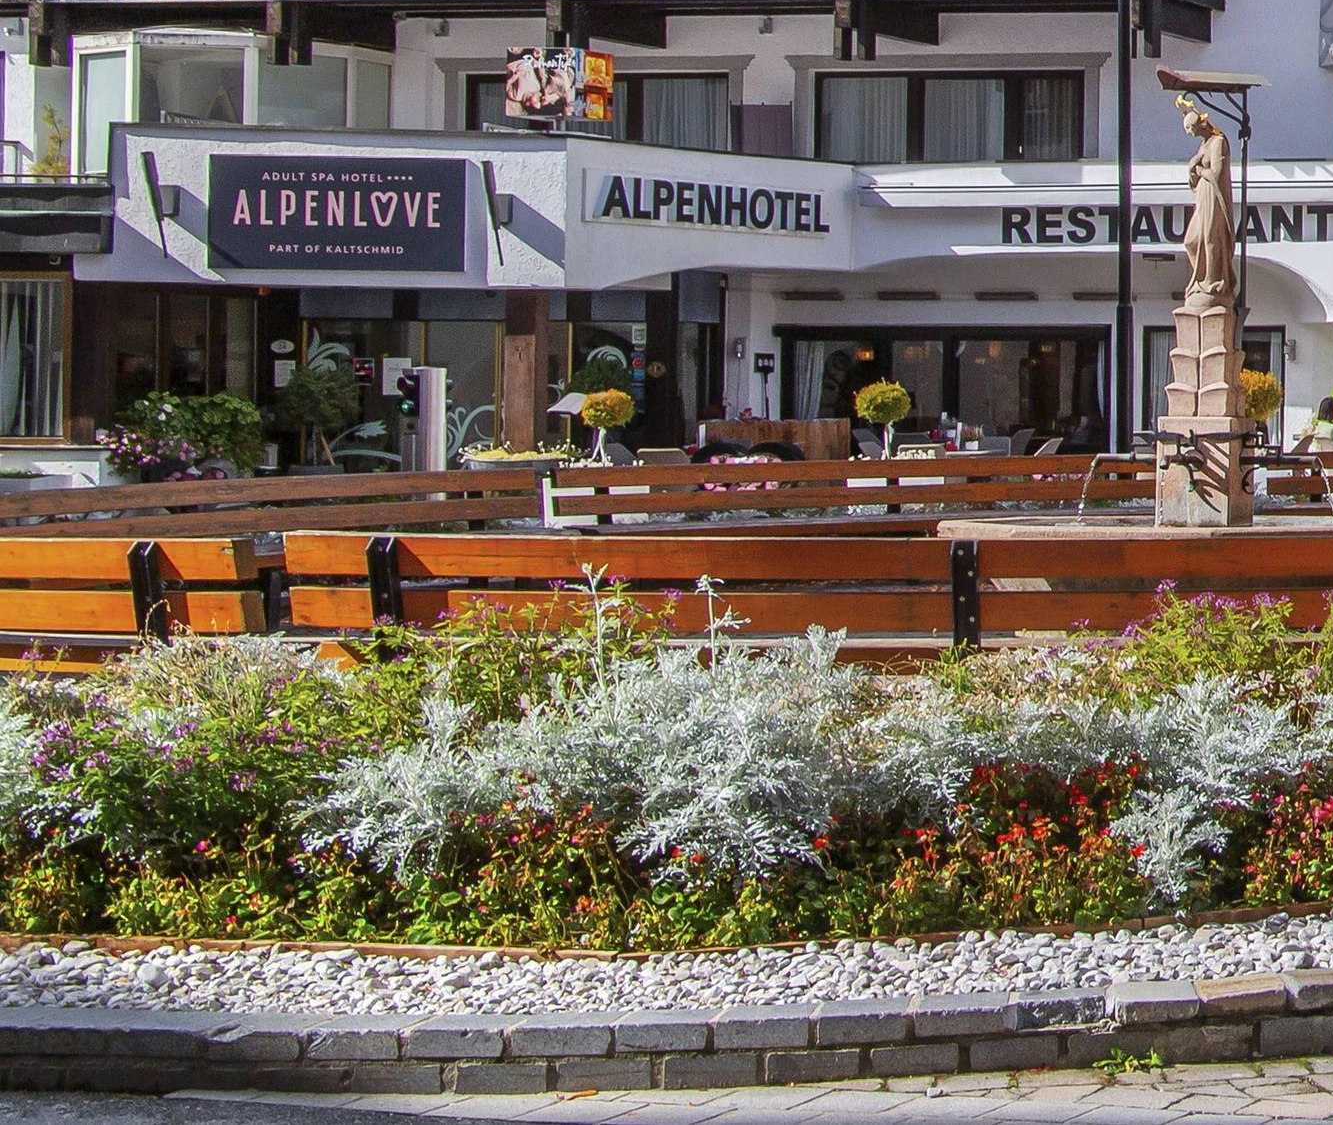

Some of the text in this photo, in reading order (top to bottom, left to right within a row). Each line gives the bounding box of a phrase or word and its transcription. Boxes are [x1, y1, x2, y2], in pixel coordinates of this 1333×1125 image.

[261, 172, 384, 183] ADULT SPA HOTEL
[232, 188, 441, 228] ALPENLOVE
[601, 175, 830, 233] ALPENHOTEL
[269, 244, 404, 255] PART OF KALTSCHMID
